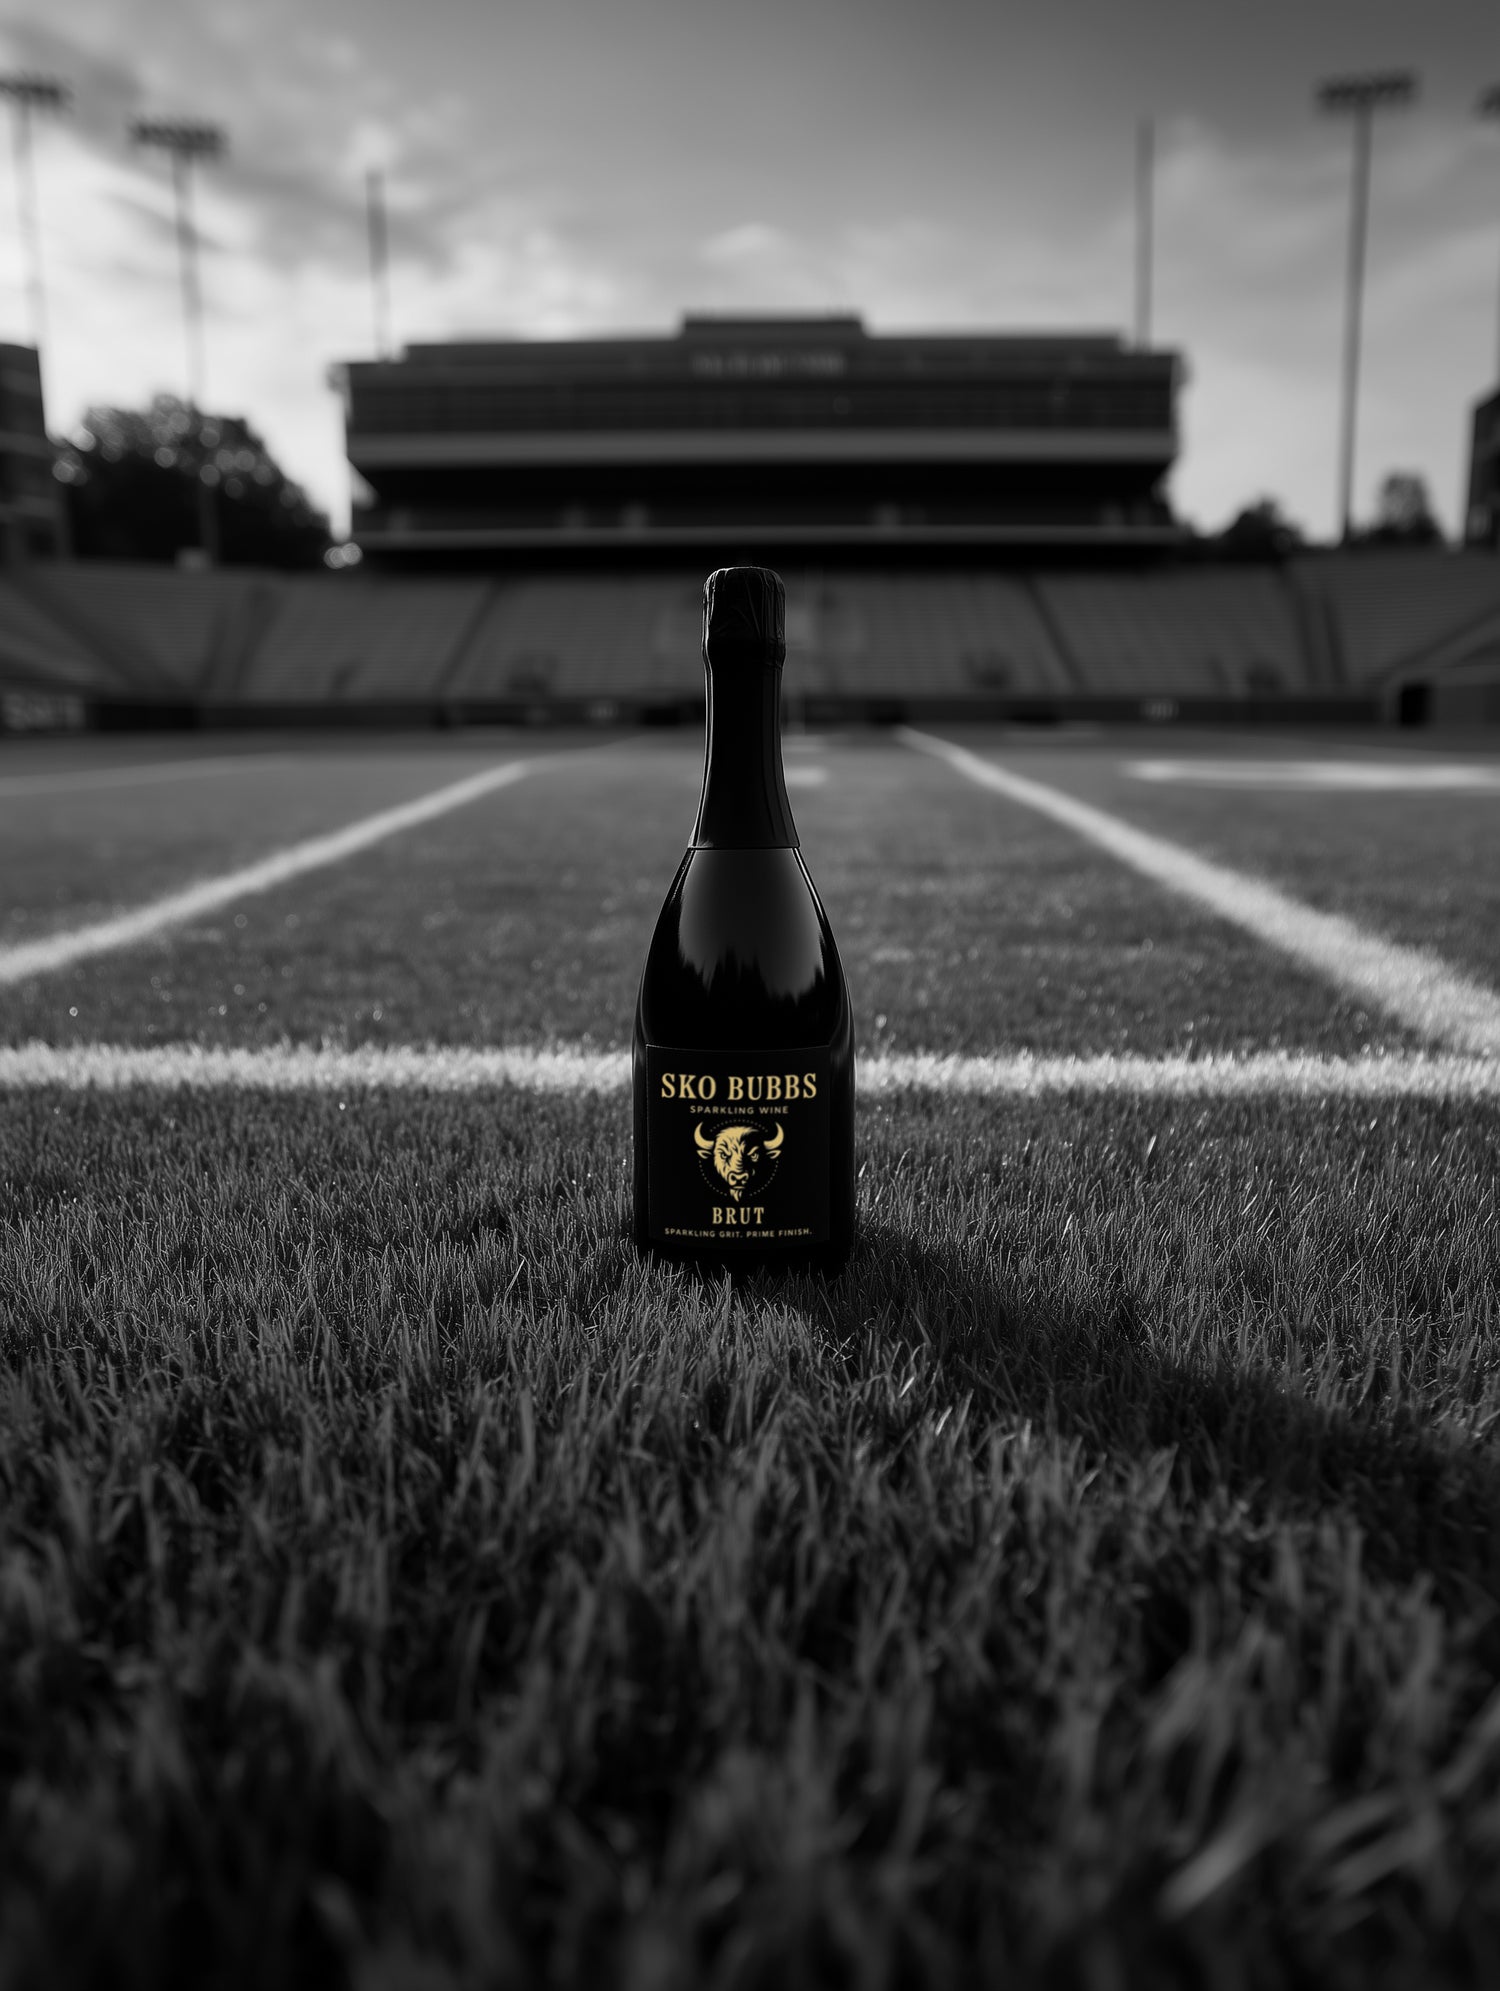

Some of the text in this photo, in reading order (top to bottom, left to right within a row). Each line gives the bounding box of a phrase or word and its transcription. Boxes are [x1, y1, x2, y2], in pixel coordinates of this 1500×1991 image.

[661, 1073, 817, 1100] SKO BUBBS
[690, 1106, 788, 1114] SPARKLING WINE
[712, 1207, 764, 1224] BRUT
[664, 1227, 716, 1238] SPARKLING
[746, 1230, 775, 1238] PRIME
